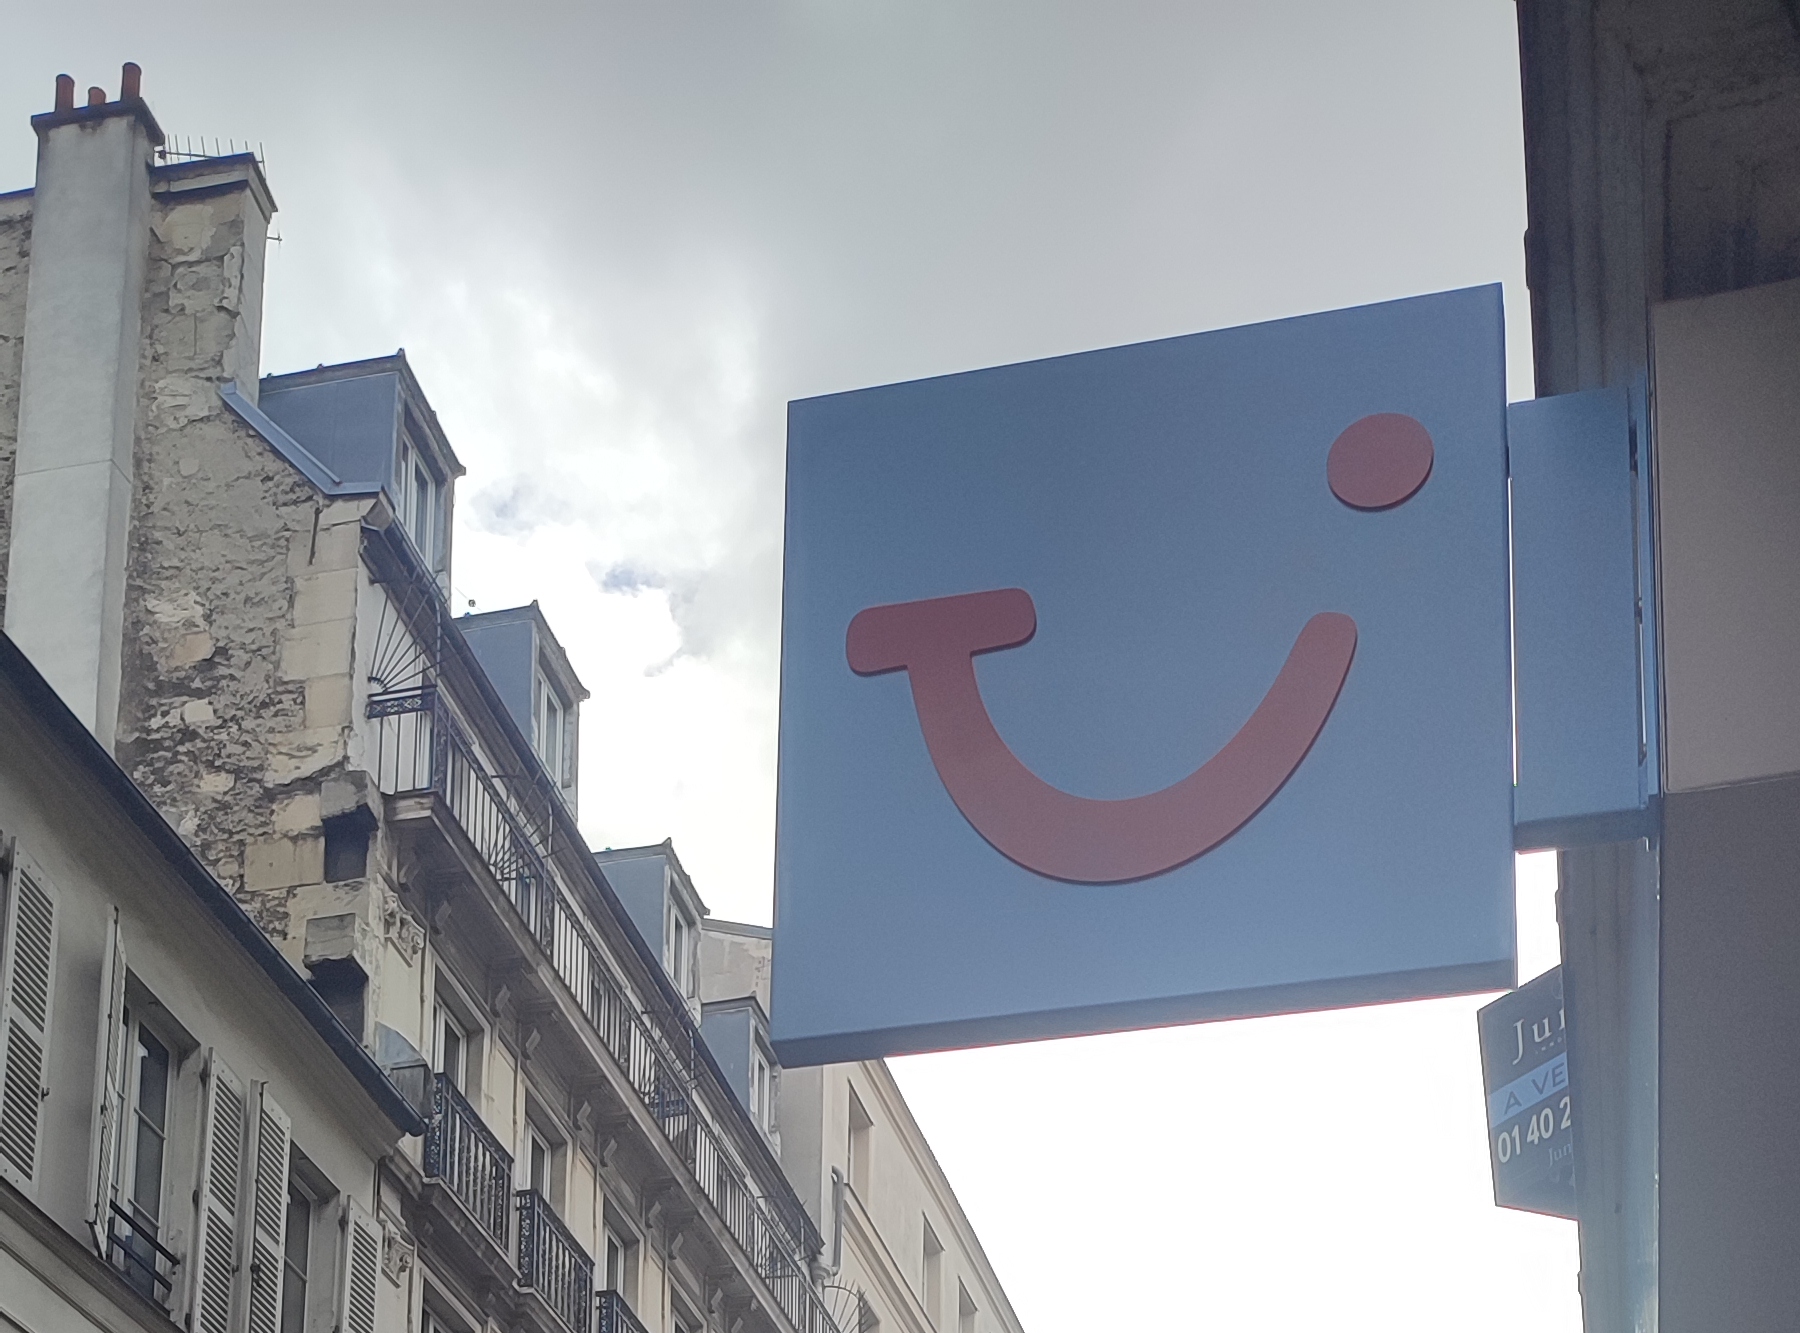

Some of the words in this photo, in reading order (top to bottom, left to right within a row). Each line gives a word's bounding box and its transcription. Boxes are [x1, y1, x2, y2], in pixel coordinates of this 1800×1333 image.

[1503, 1090, 1522, 1115] A
[1531, 1063, 1566, 1096] VE
[1497, 1124, 1521, 1164] 01
[1526, 1107, 1554, 1146] 40
